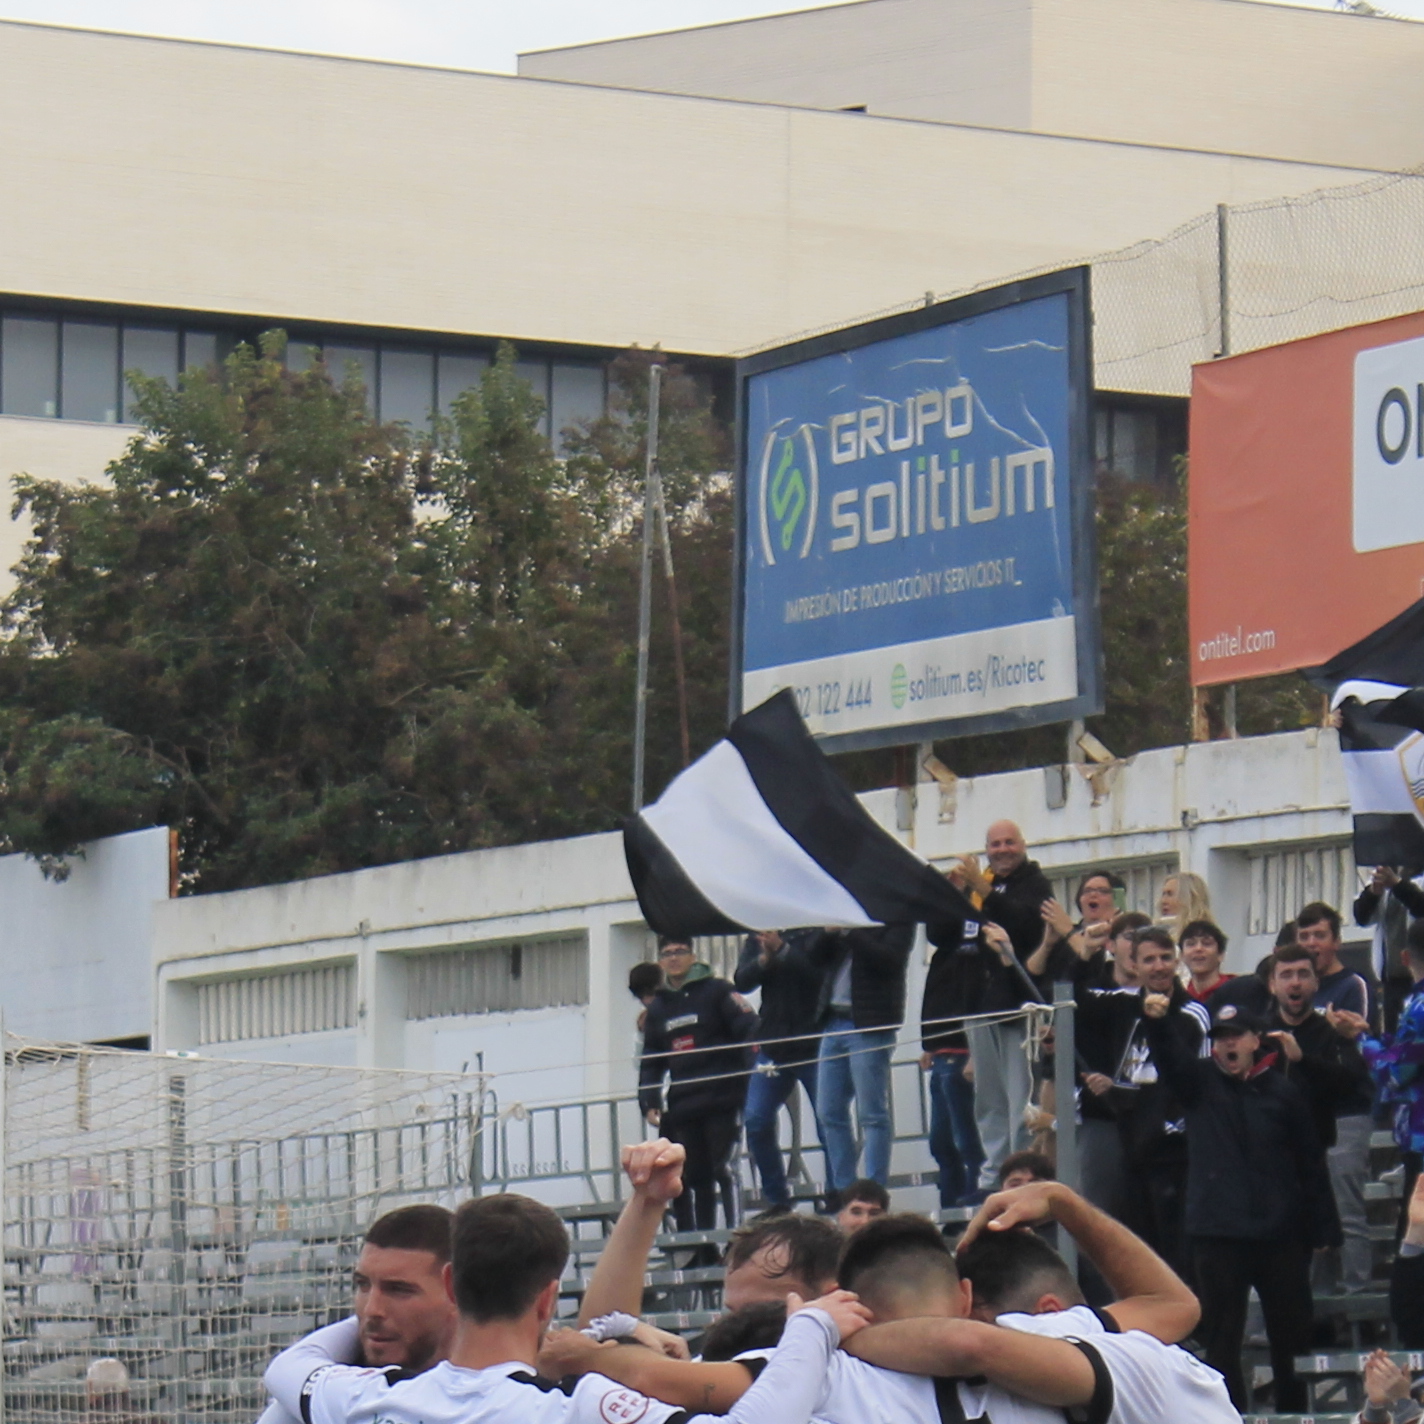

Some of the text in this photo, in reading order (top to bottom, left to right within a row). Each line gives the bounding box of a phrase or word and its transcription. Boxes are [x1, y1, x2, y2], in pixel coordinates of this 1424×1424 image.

[830, 384, 974, 465] GRUPO
[831, 448, 1054, 552] solitium
[1198, 625, 1276, 662] ontitel.com
[845, 677, 873, 710] 444
